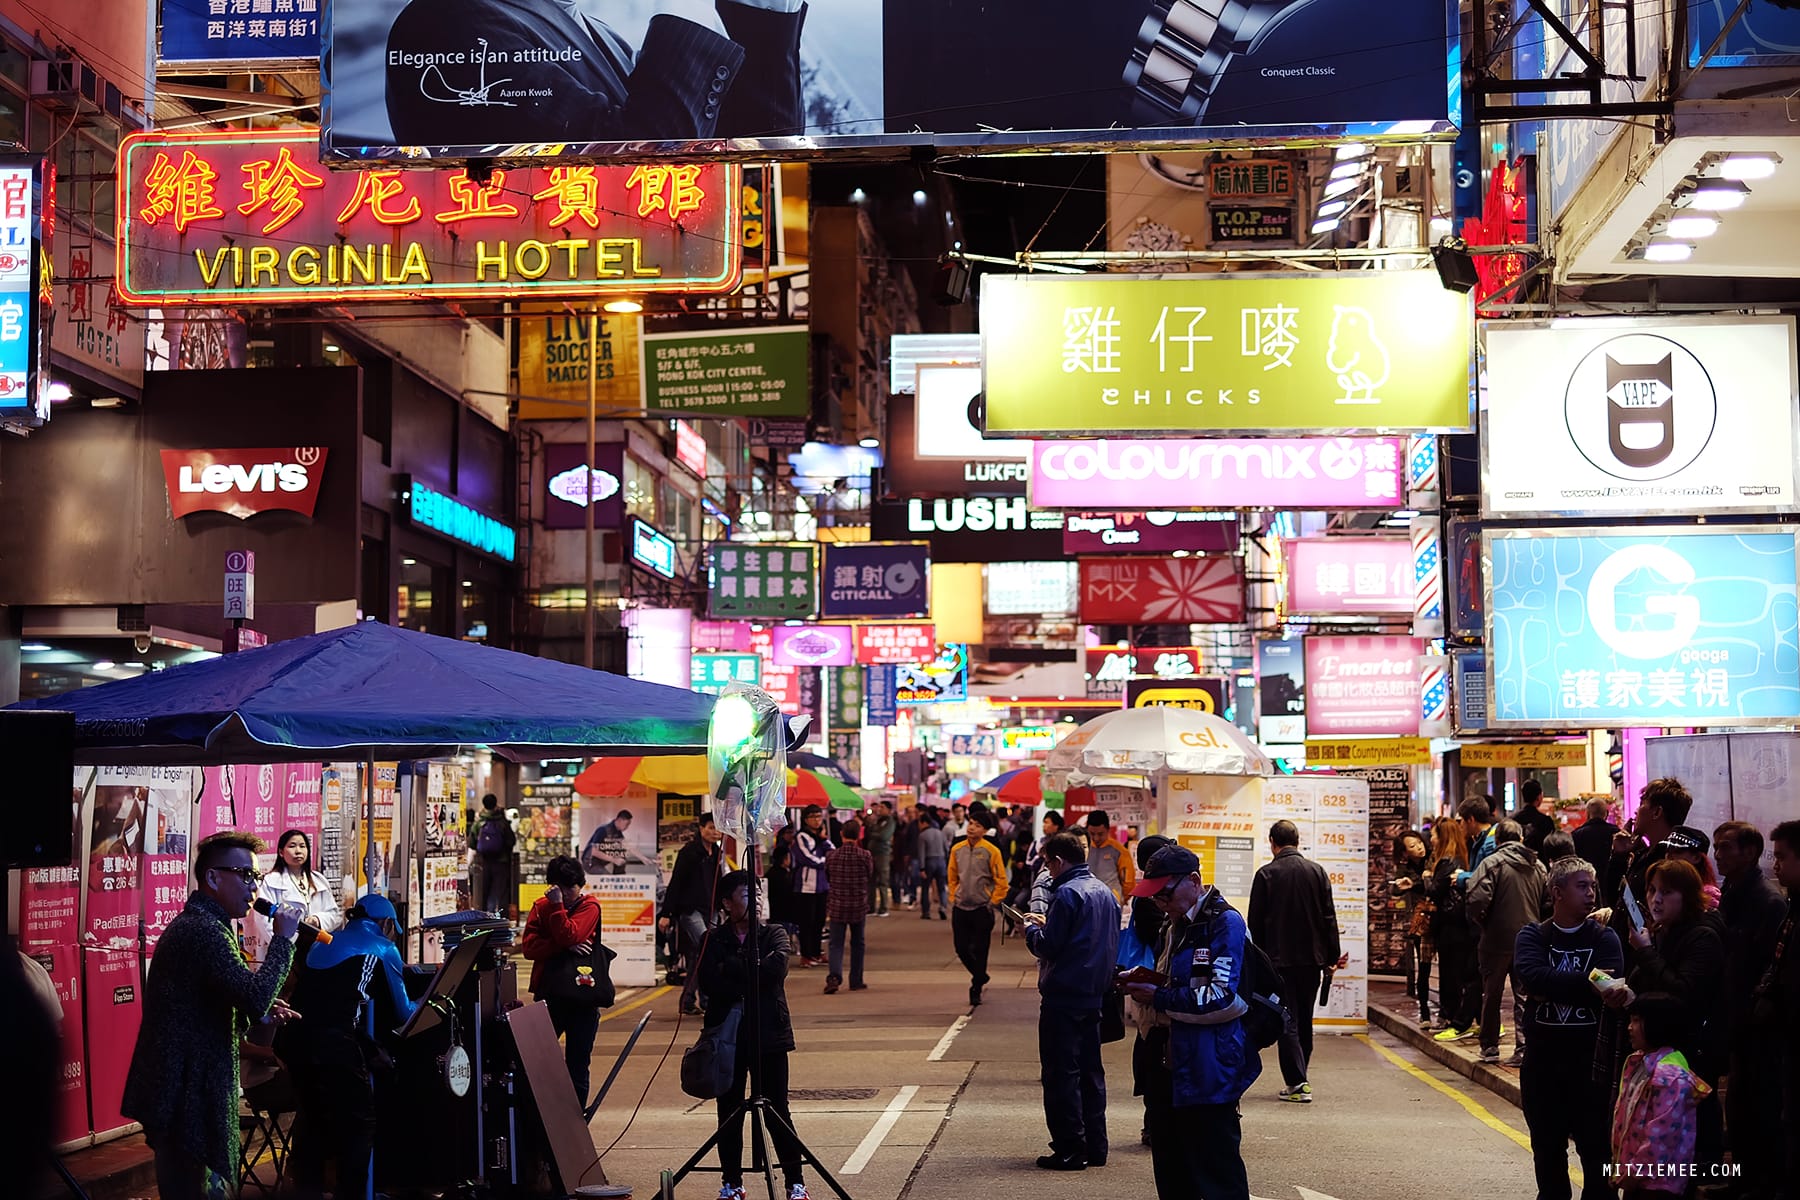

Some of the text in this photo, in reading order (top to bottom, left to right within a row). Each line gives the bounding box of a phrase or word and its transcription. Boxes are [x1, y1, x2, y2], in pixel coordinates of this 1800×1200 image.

[207, 19, 317, 39] 西洋菜南街1
[389, 47, 582, 68] Elegance is an attitude
[1261, 65, 1336, 78] Conquest Classic
[500, 87, 553, 98] Aaron Kwok
[1213, 165, 1289, 194] 榆林書店
[1216, 211, 1288, 225] T.O.P Hair
[476, 238, 661, 282] HOTEL
[76, 321, 121, 368] HOTEL
[1062, 303, 1300, 374] 雞仔嘜
[546, 363, 614, 383] MATCES
[657, 372, 684, 382] MONG
[686, 370, 705, 380] KOK
[706, 368, 726, 378] CITY
[658, 385, 699, 396] BUSINESS
[701, 383, 724, 393] HOUR
[1102, 388, 1262, 406] CHICKS
[1622, 382, 1658, 406] VAPE
[659, 399, 674, 408] TEL
[908, 497, 1027, 532] LUSH
[227, 578, 244, 614] 旺角
[831, 590, 893, 601] CITICALL
[1088, 583, 1137, 602] MX
[1561, 668, 1731, 709] 護家美視
[1179, 727, 1228, 749] csl.
[1352, 743, 1400, 762] Countrywind
